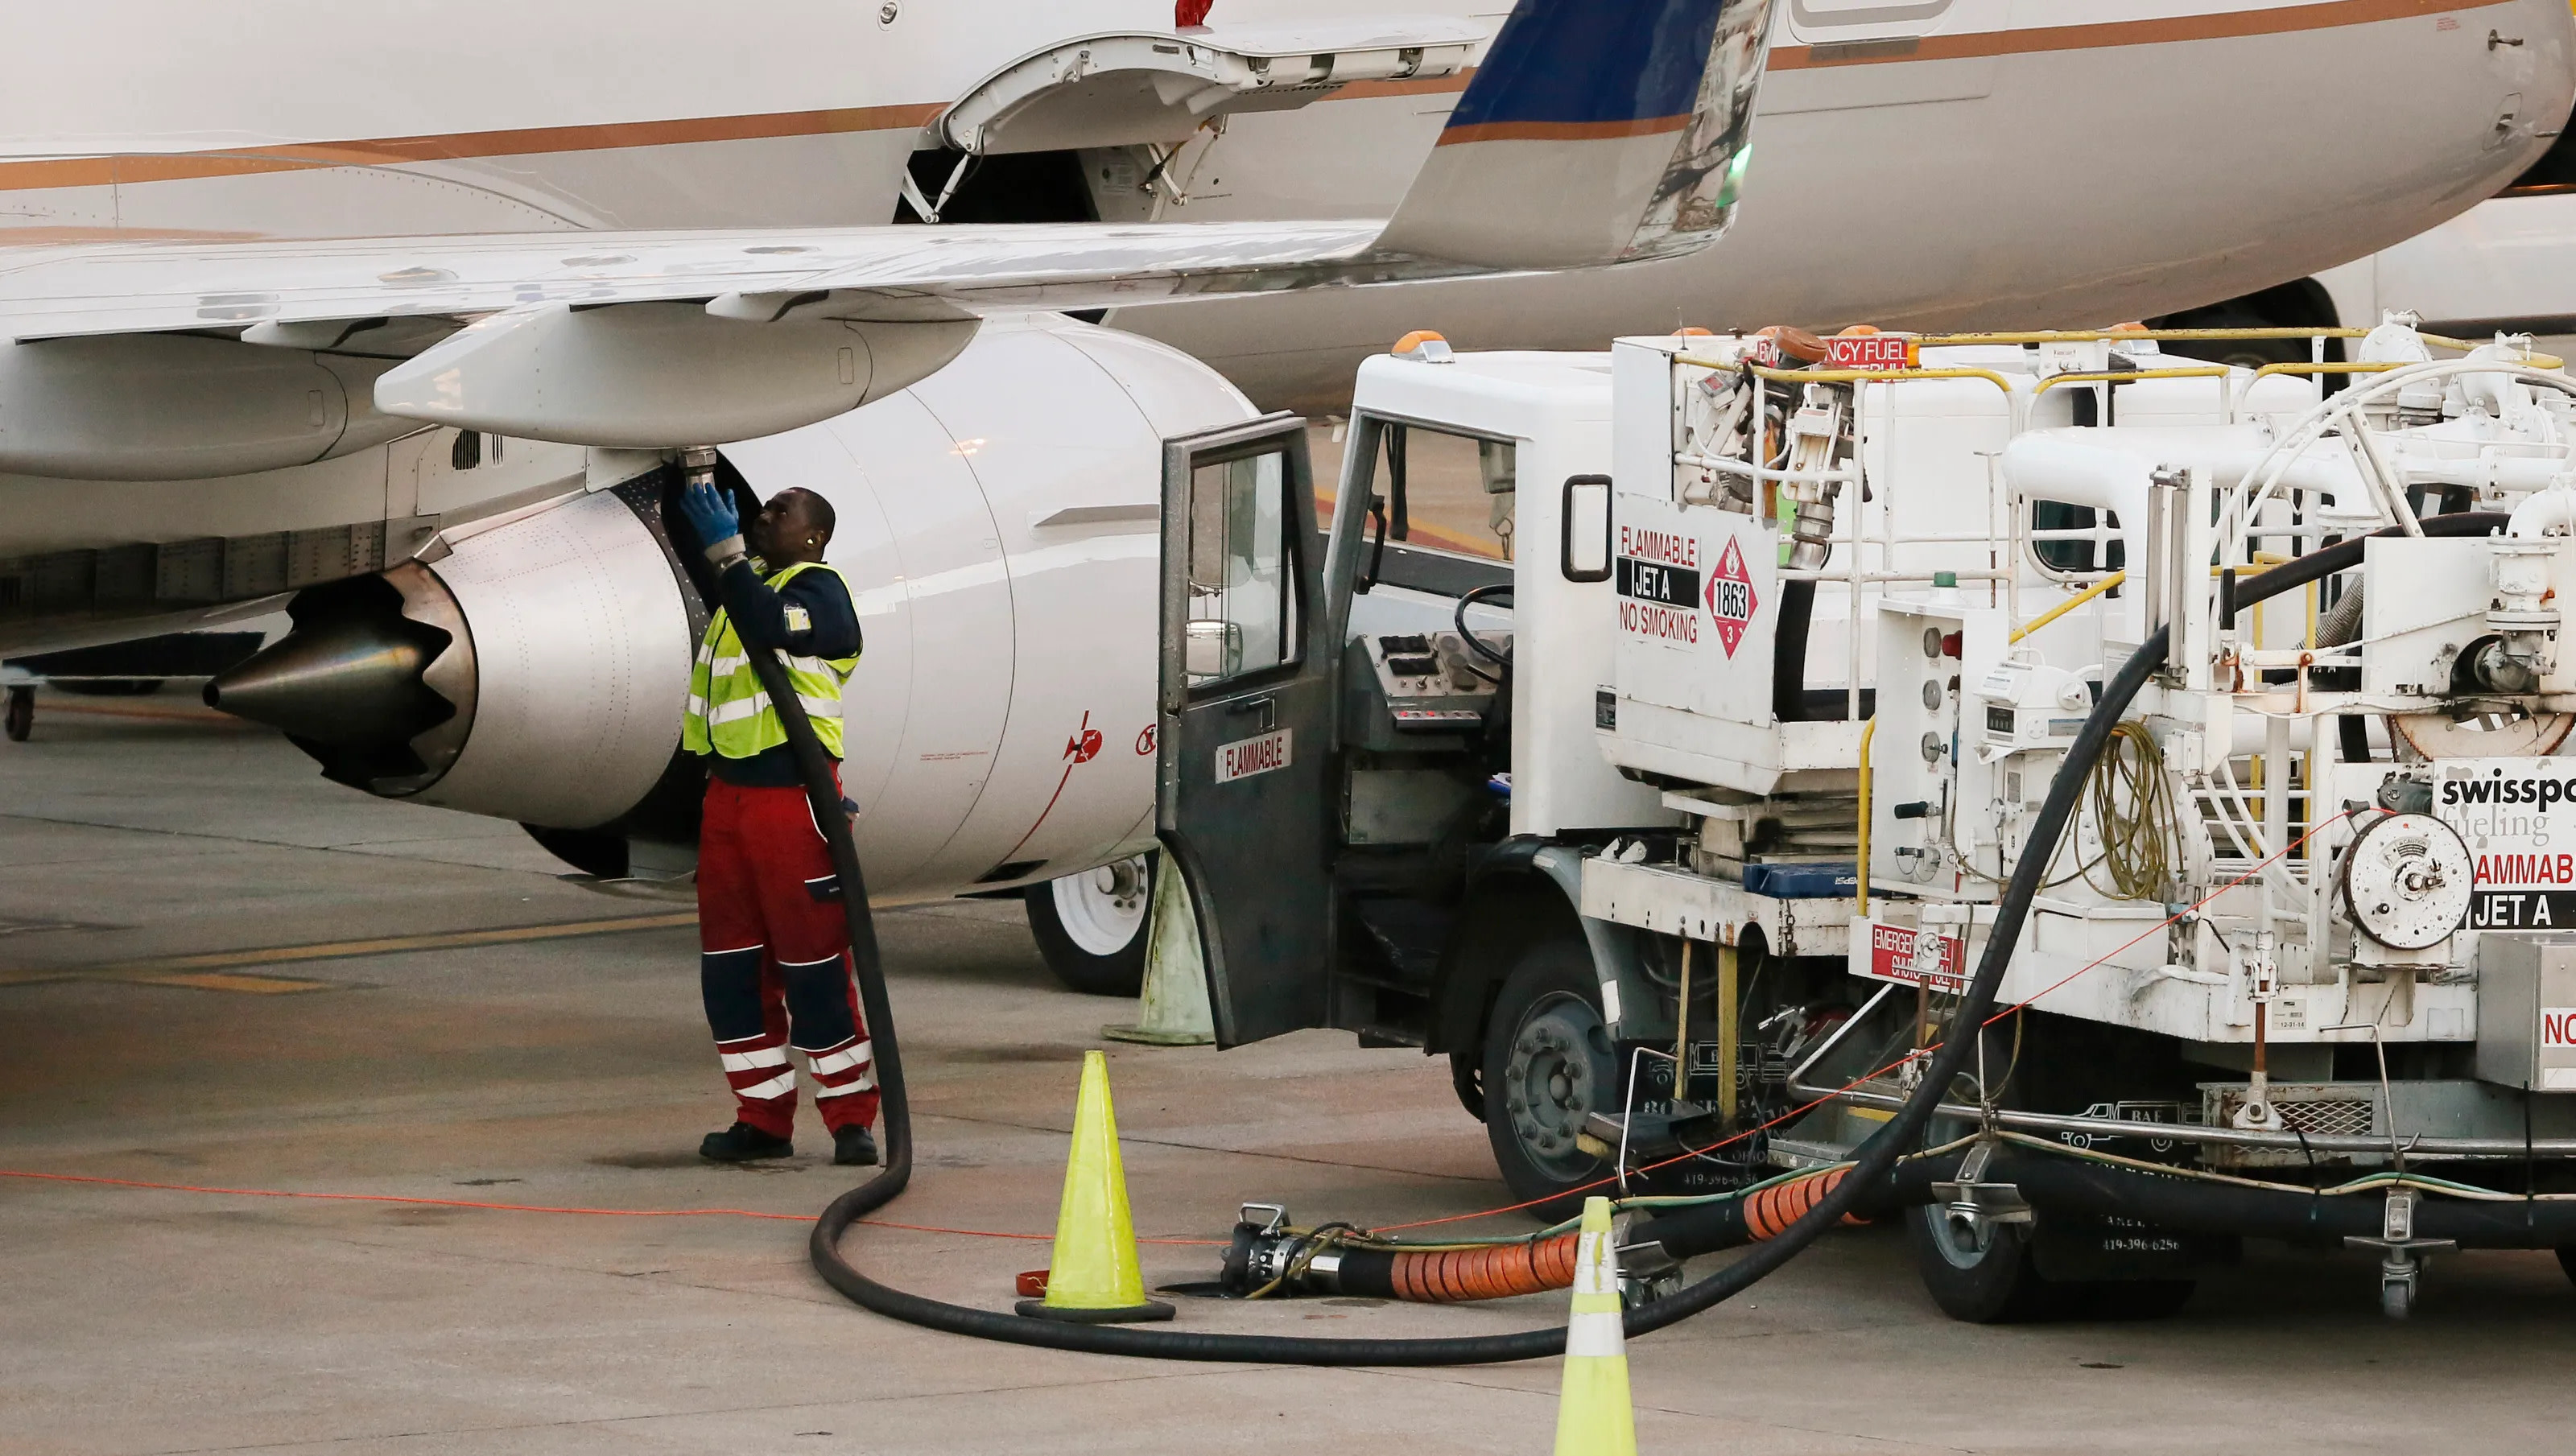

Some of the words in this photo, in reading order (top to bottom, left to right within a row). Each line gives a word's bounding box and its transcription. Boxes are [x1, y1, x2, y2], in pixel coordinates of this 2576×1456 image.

[1865, 340, 1909, 361] FUEL
[1621, 526, 1695, 567] FLAMMABLE
[1636, 565, 1659, 597] JET
[1661, 569, 1670, 600] A
[1717, 581, 1747, 619] 1863
[1620, 600, 1637, 633] NO
[1641, 605, 1698, 645] SMOKING
[1727, 625, 1734, 644] 3
[1226, 736, 1283, 778] FLAMMABLE
[2442, 805, 2550, 847] fueling
[1835, 876, 1857, 885] EPSI
[2474, 854, 2576, 885] AMMAB
[2475, 894, 2526, 926] JET
[2533, 894, 2553, 926] A
[1684, 1173, 1759, 1186] 419-396-656
